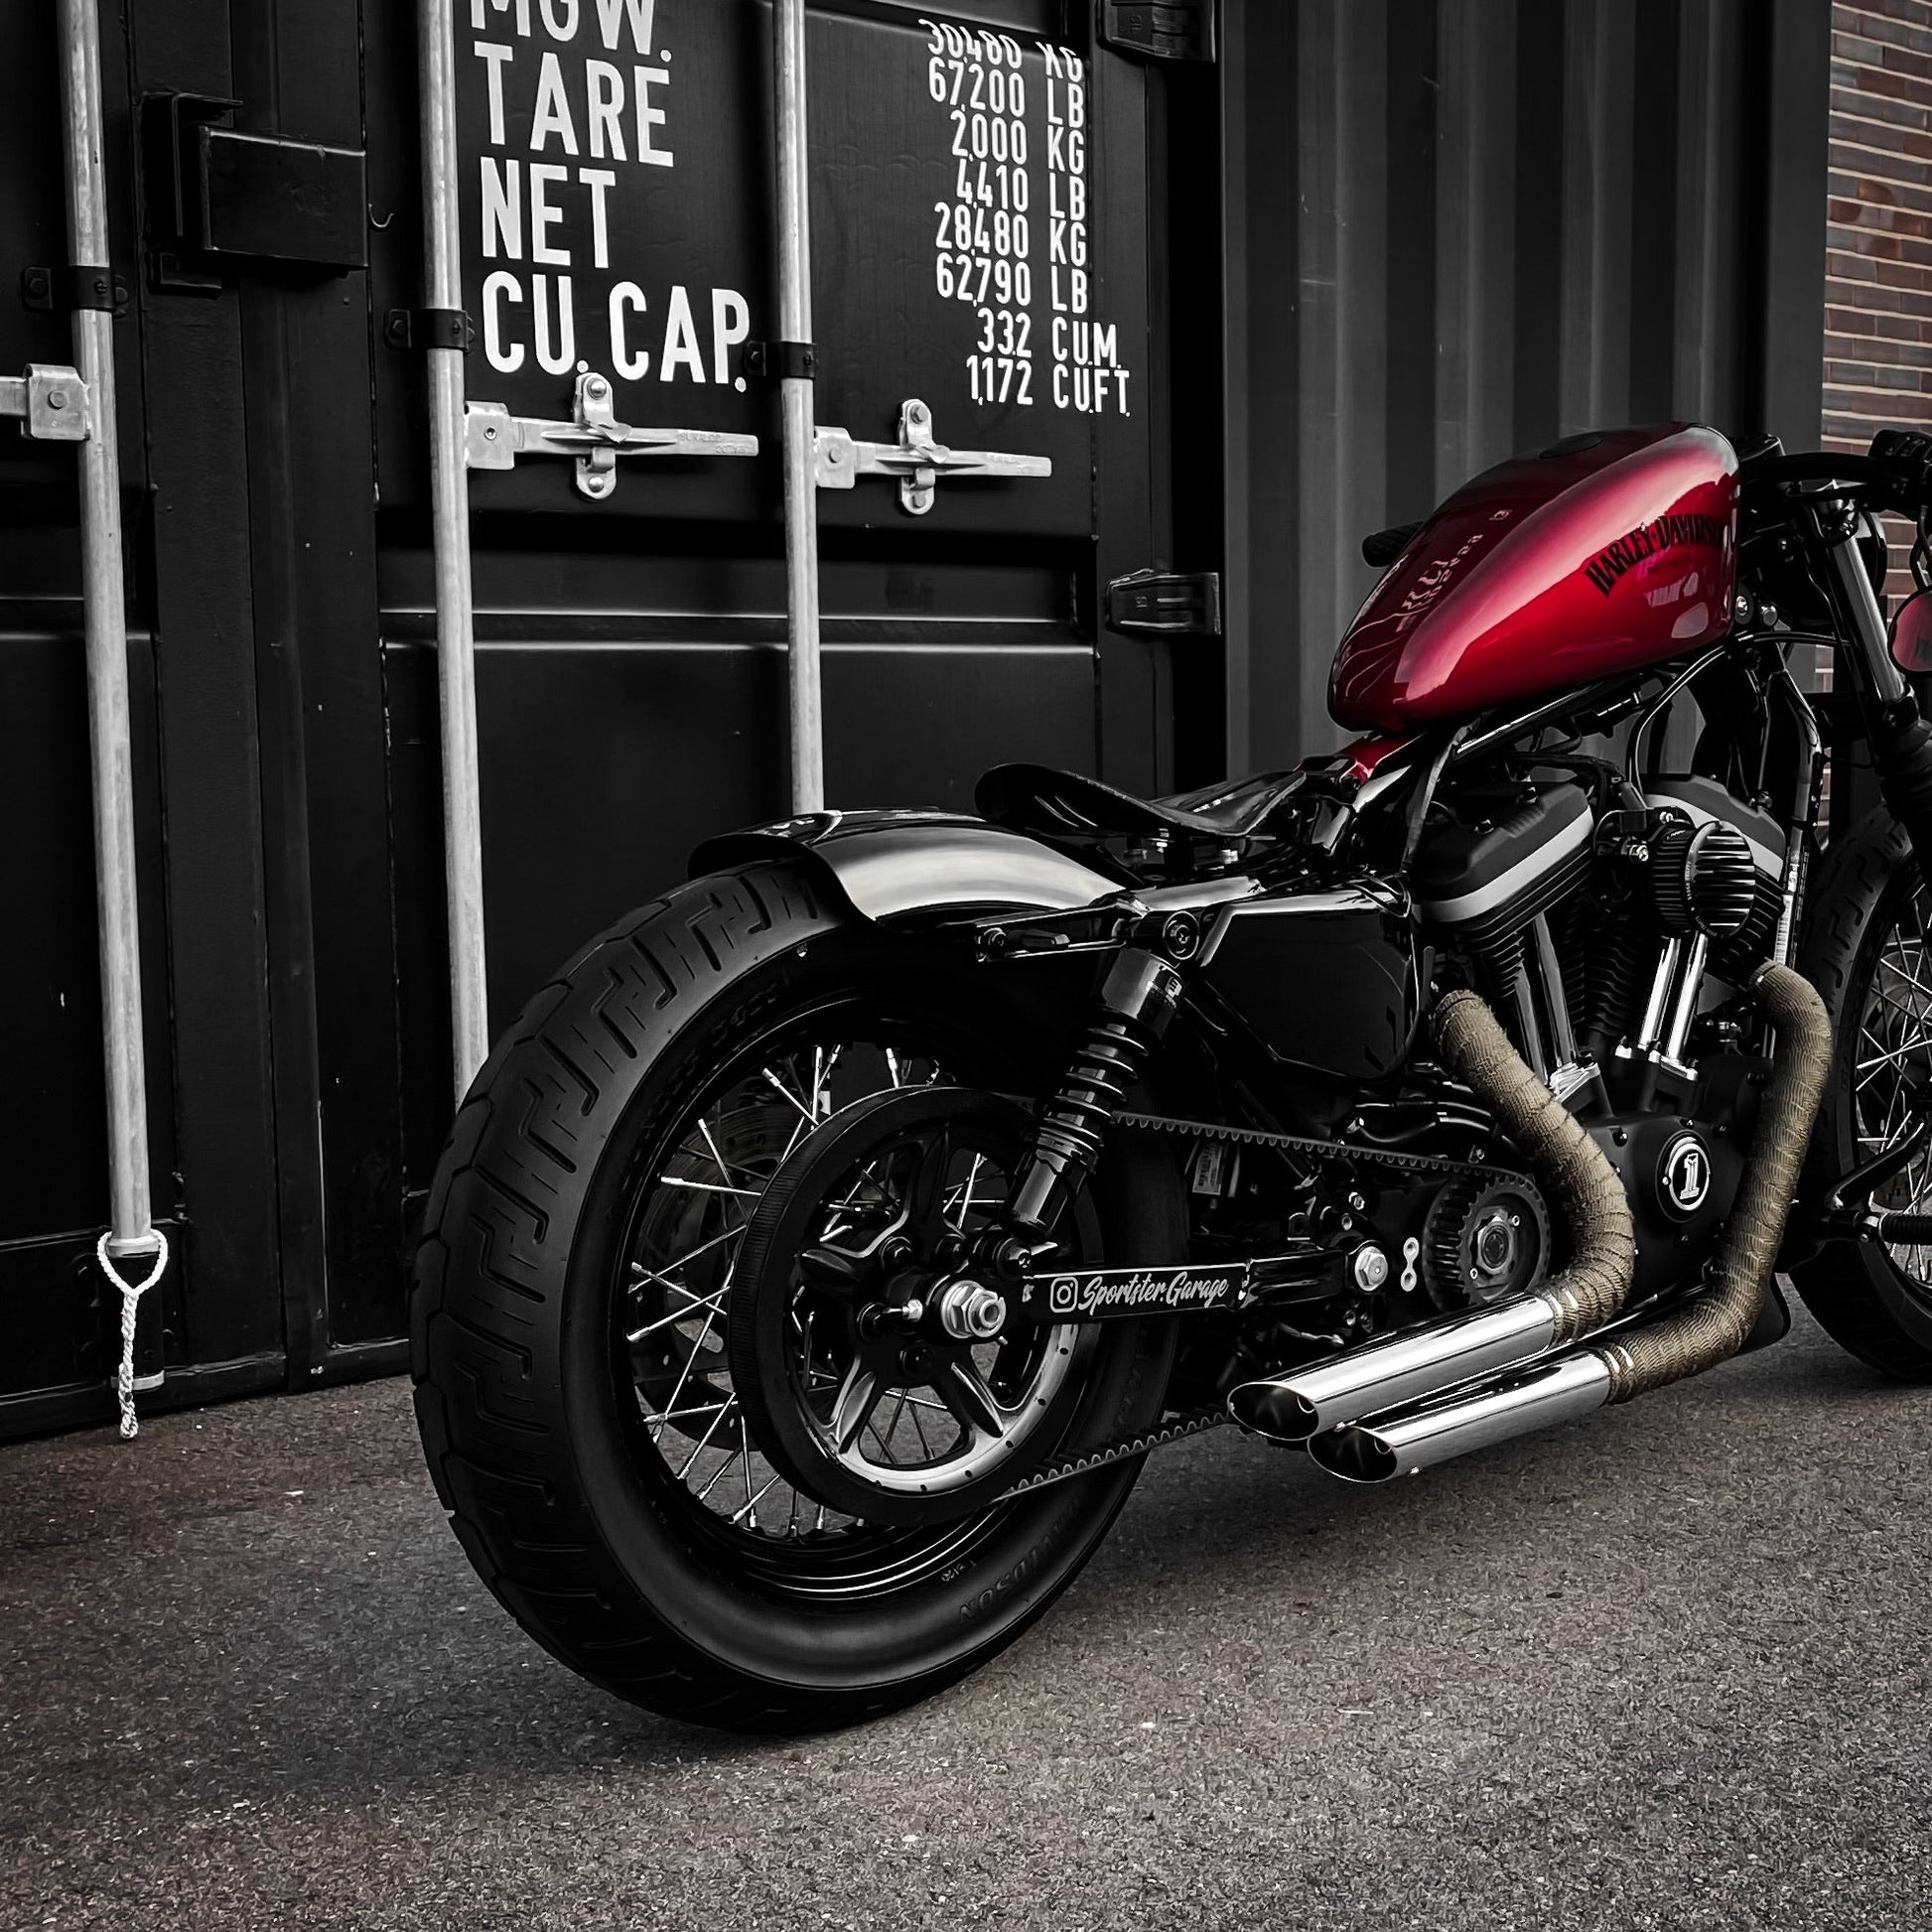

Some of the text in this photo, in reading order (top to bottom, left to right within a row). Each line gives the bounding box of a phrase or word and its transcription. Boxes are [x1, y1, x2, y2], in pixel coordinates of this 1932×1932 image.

[928, 57, 1084, 128] 67,200 LB
[1035, 42, 1084, 82] KG
[474, 41, 674, 167] TARE
[950, 110, 1084, 175] 2,000 KG
[481, 156, 616, 268] NET
[1049, 172, 1085, 220] LB
[934, 202, 1086, 266] 28,480 KG
[936, 252, 1087, 314] 62,790 LB
[609, 281, 751, 393] CAP.
[977, 307, 1032, 357] 33.2
[966, 354, 1033, 405] 1,172
[1585, 514, 1726, 598] HARLEY-DAVIDSO
[1078, 1271, 1229, 1315] Sportster.Garage
